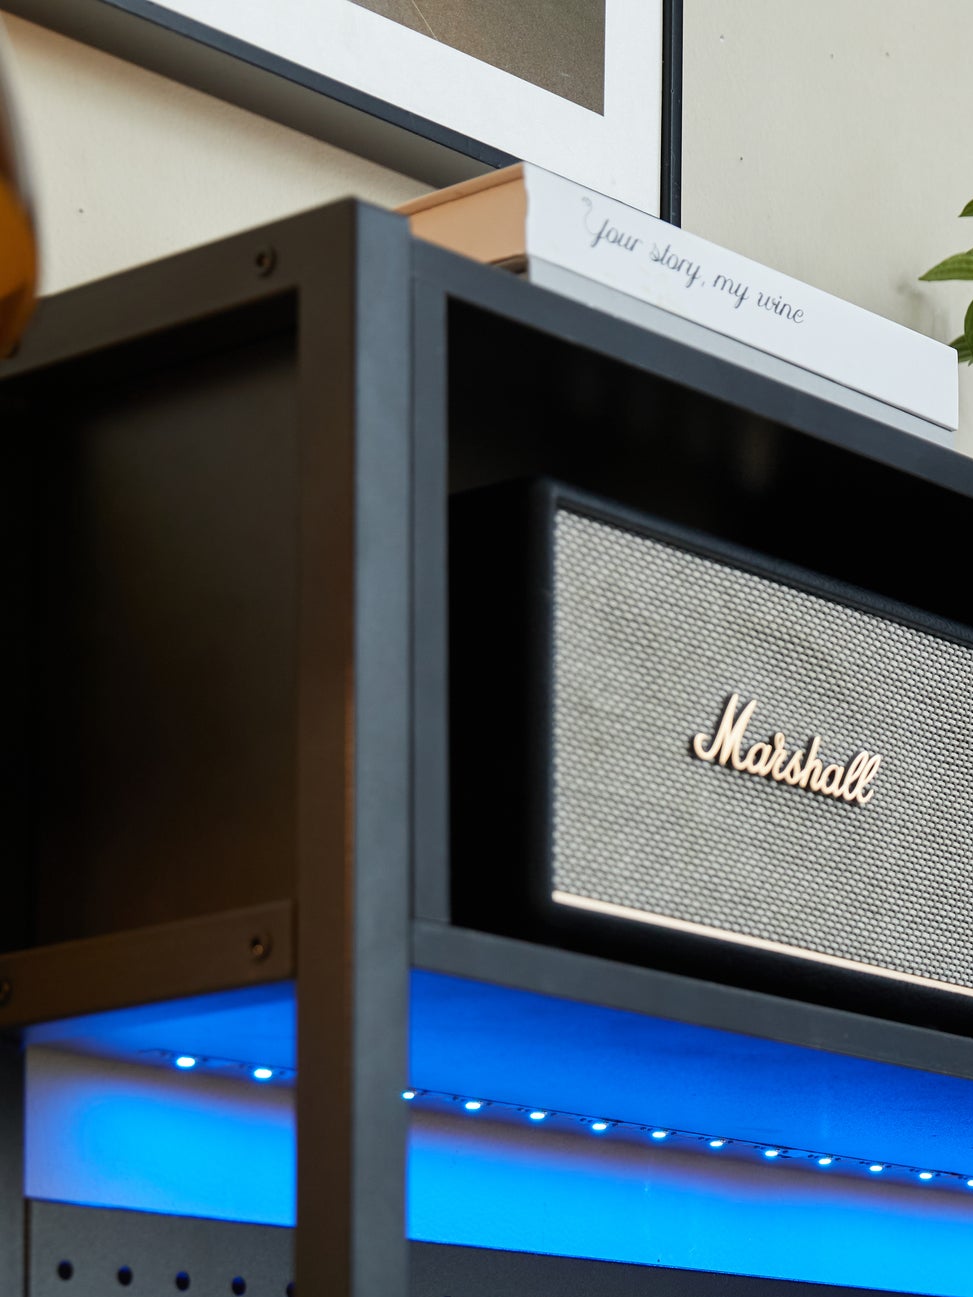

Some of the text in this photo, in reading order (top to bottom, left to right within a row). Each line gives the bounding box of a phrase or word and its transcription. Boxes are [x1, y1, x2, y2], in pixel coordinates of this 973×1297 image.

[581, 196, 805, 324] Your story, my wine
[693, 693, 883, 806] Marshall
